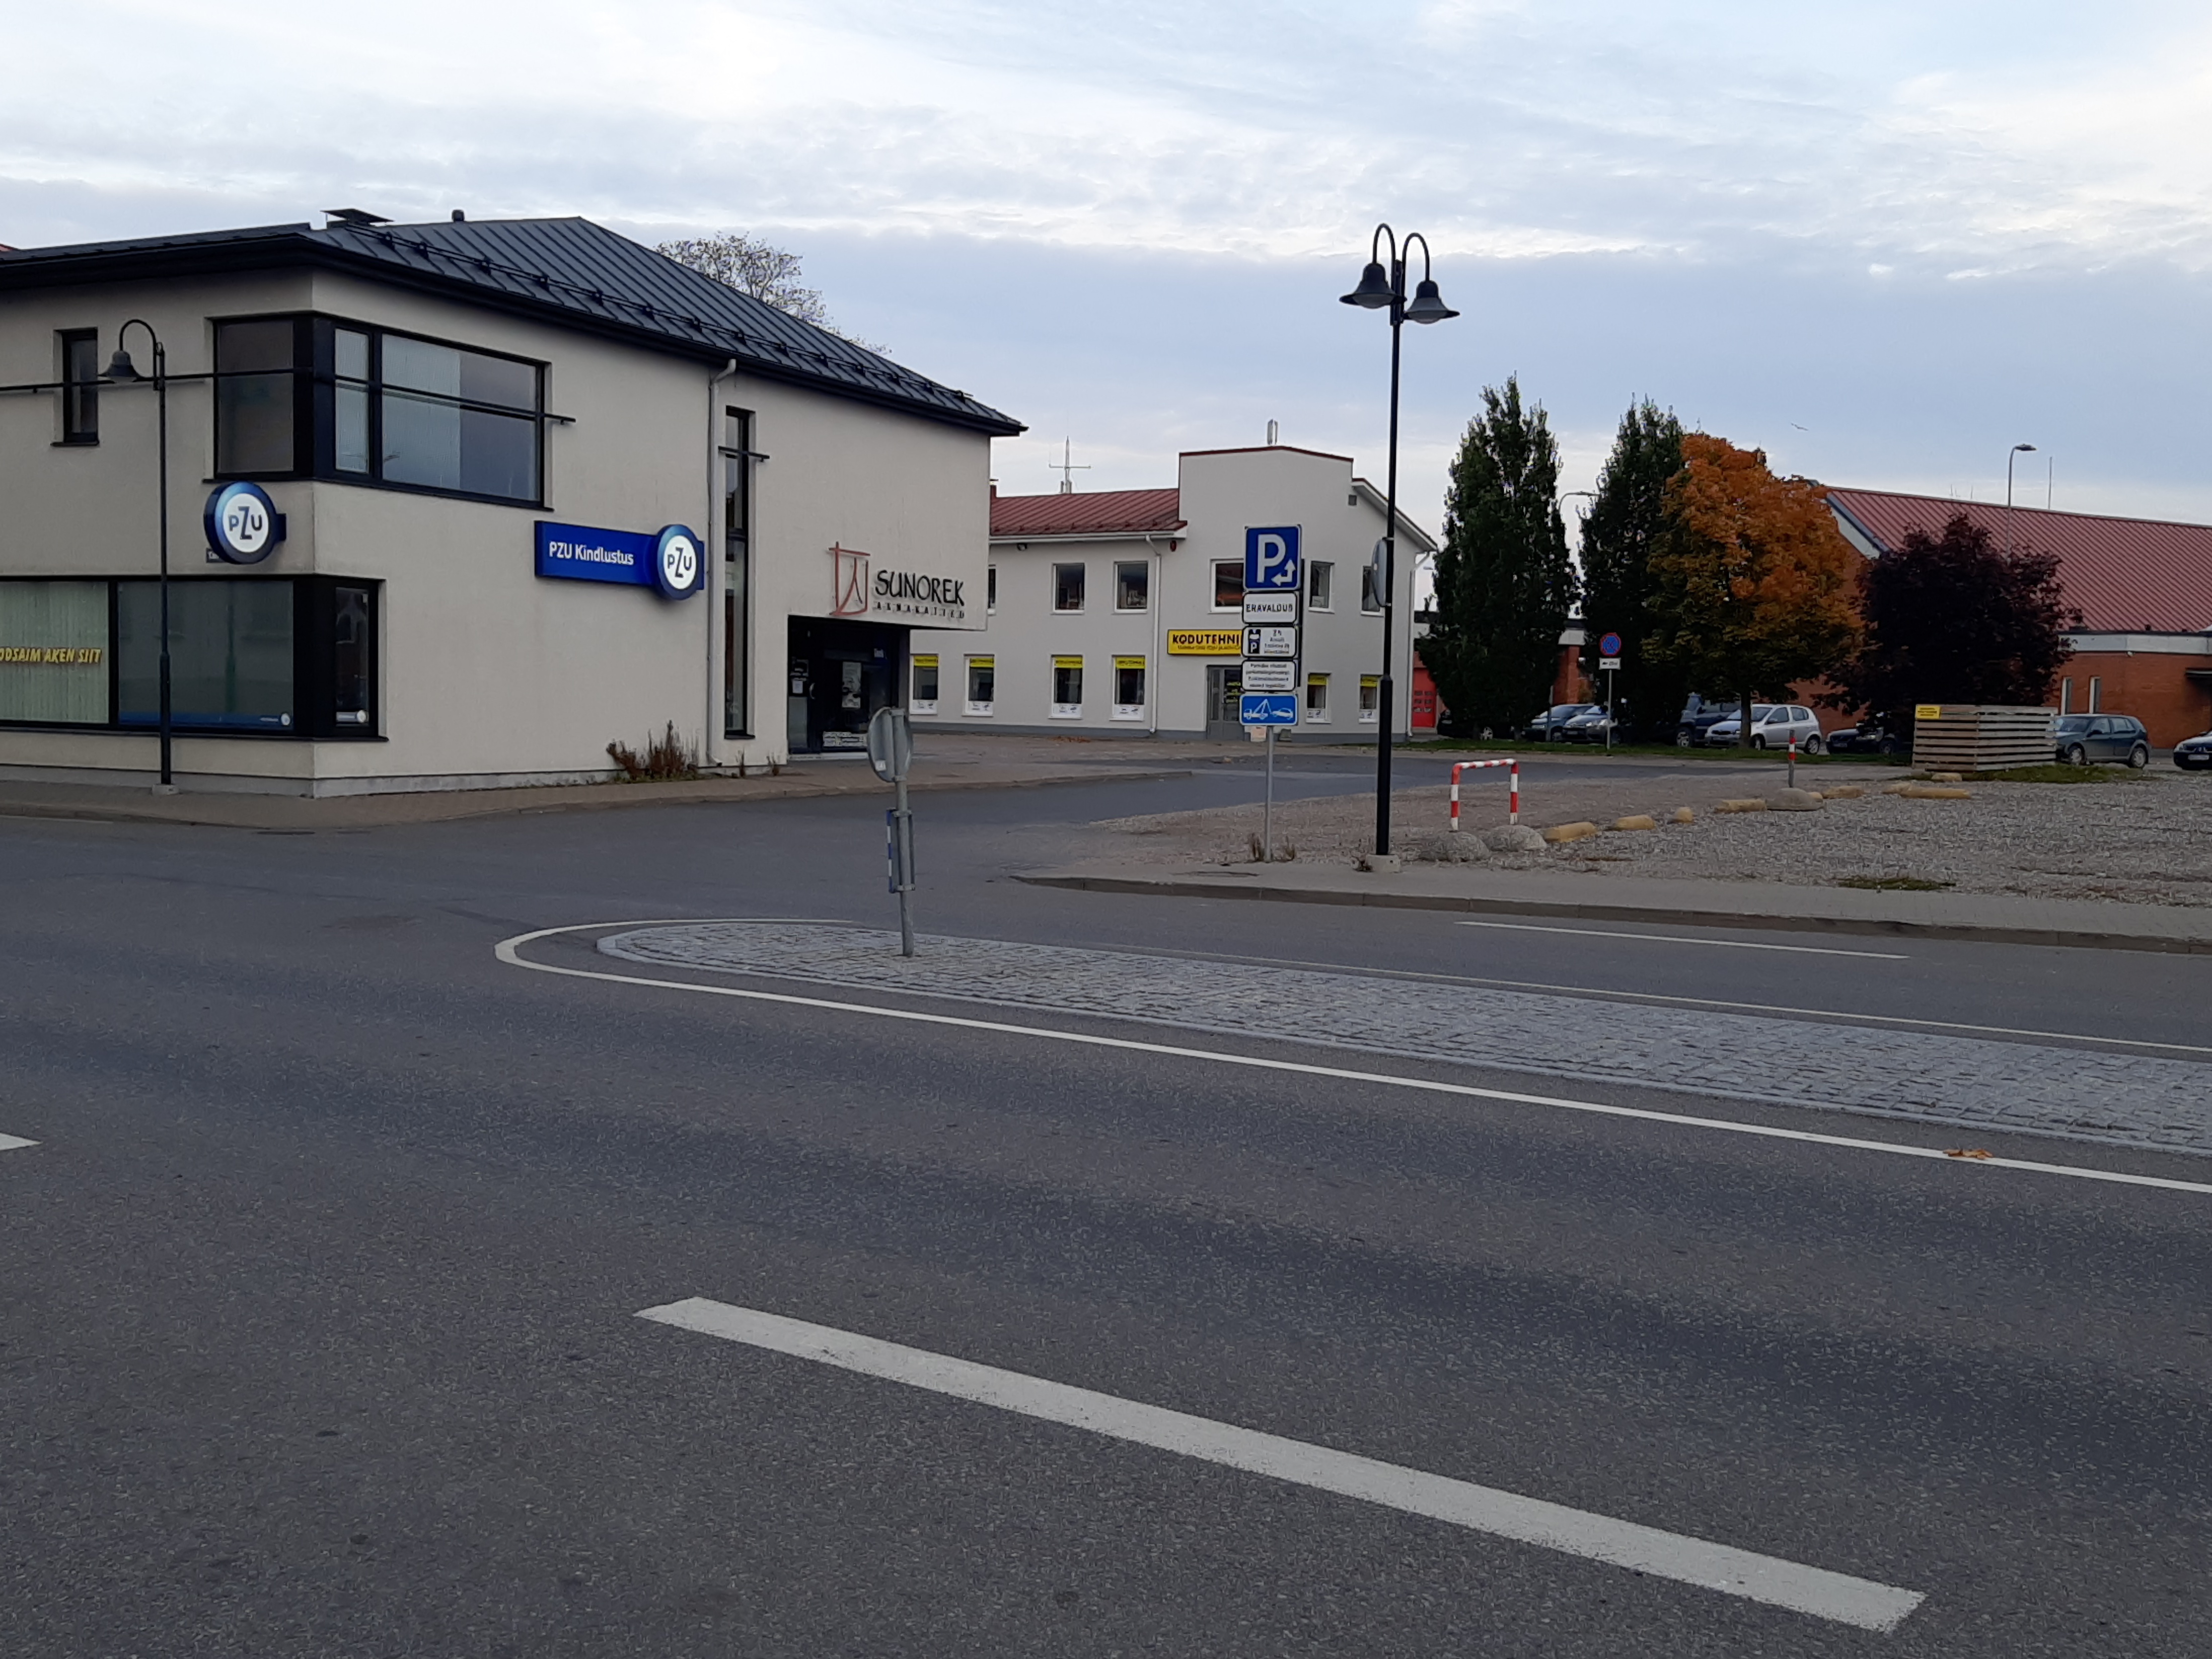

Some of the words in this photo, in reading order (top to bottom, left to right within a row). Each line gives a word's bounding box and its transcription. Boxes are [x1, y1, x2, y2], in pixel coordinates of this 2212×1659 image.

[228, 506, 262, 540] PZU
[549, 541, 572, 559] PZU
[575, 544, 634, 565] Kindlustus
[668, 547, 692, 578] PZU
[1257, 534, 1286, 583] P
[875, 569, 965, 606] SUNOREK
[44, 647, 75, 663] AKEN
[78, 648, 102, 663] SIIT
